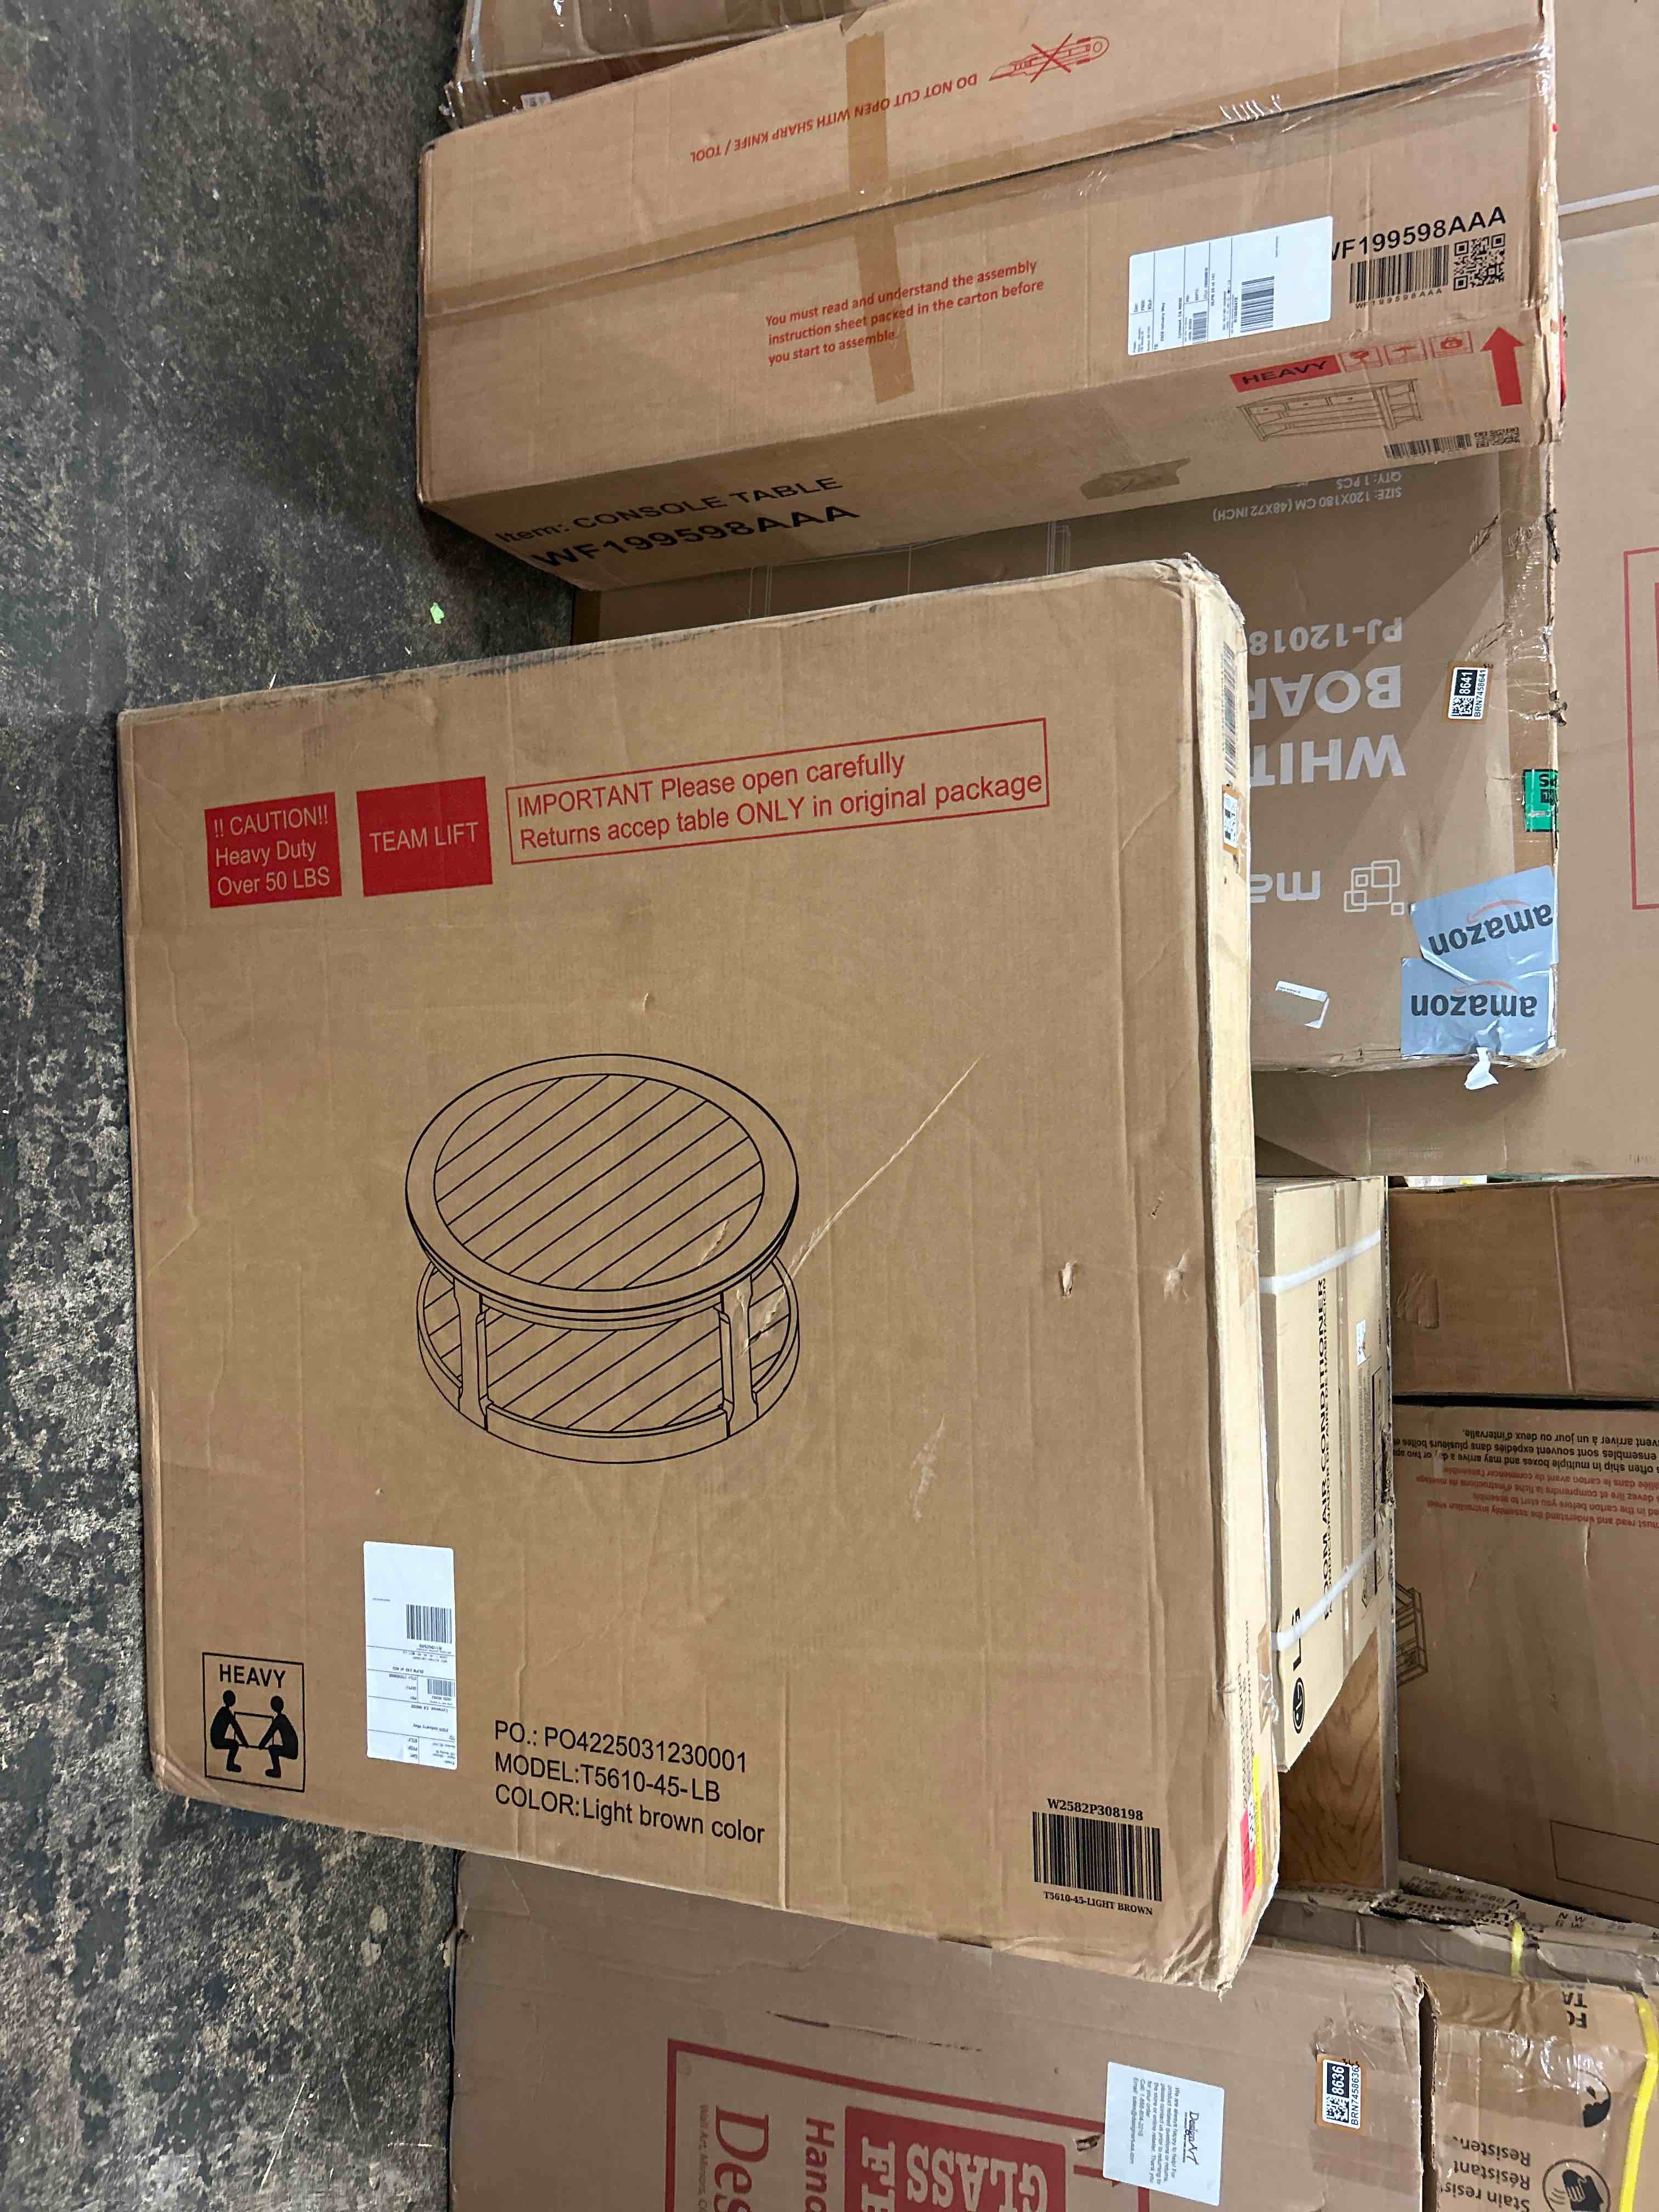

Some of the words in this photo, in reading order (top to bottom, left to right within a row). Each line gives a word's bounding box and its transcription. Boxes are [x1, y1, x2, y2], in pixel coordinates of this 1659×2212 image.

[956, 72, 977, 87] DO
[924, 81, 952, 98] NOT
[894, 89, 919, 107] CUT
[855, 98, 890, 116] OPEN
[816, 107, 851, 127] WITH
[772, 119, 813, 140] SHARP
[725, 138, 732, 155] /
[733, 132, 770, 151] KNIFE
[691, 145, 721, 162] TOOL
[766, 315, 785, 326] You
[789, 307, 819, 322] must
[822, 301, 848, 315] read
[852, 294, 874, 308] and
[878, 278, 949, 304] understand
[952, 274, 973, 286] the
[977, 260, 1037, 284] assembly
[769, 324, 831, 345] instruction
[834, 316, 867, 332] sheet
[871, 305, 913, 326] packed
[917, 304, 929, 315] in
[933, 298, 953, 312] the
[957, 291, 998, 307] carton
[1002, 280, 1043, 298] before
[768, 352, 789, 366] you
[793, 345, 820, 359] start
[823, 342, 836, 353] to
[1242, 359, 1327, 385] HEAVY
[1336, 476, 1360, 490] PCS
[1364, 474, 1369, 487] 1
[1373, 471, 1402, 485] QTY:
[1319, 490, 1370, 509] 120X180
[1374, 486, 1403, 500] SIZE:
[494, 521, 570, 545] Item:
[573, 495, 727, 529] CONSOLE
[730, 477, 843, 504] TABLE
[1251, 498, 1293, 519] (48X72
[1295, 498, 1316, 511] CM
[1212, 507, 1248, 522] INCH)
[531, 505, 860, 567] WF199598AAA
[1459, 672, 1474, 694] 8641
[1474, 669, 1486, 717] BRN7458641
[517, 780, 653, 818] IMPORTANT
[661, 775, 735, 802] Please
[742, 767, 798, 794] open
[806, 751, 905, 782] carefully
[521, 822, 601, 851] Returns
[607, 817, 670, 842] accep
[677, 809, 729, 832] table
[736, 796, 804, 826] ONLY
[813, 795, 832, 818] in
[839, 783, 926, 817] original
[934, 771, 1042, 807] package
[230, 804, 329, 836] CAUTION!!
[370, 827, 428, 853] TEAM
[435, 822, 478, 846] LIFT
[216, 846, 270, 867] Heavy
[276, 839, 317, 861] Duty
[218, 876, 260, 896] Over
[266, 872, 287, 892] 50
[294, 866, 330, 888] LBS
[1427, 904, 1553, 956] amazon
[1410, 994, 1537, 1018] amazon
[1318, 1278, 1326, 1468] CONDITIONER
[1462, 1429, 1513, 1441] d'intervalle.
[1515, 1432, 1537, 1442] deux
[1540, 1434, 1551, 1442] ou
[1554, 1432, 1573, 1443] jour
[1576, 1435, 1589, 1443] un
[1601, 1436, 1633, 1447] arriver
[1430, 1440, 1468, 1452] plusieurs
[1471, 1443, 1492, 1453] dans
[1536, 1446, 1575, 1457] souvent
[1407, 1451, 1421, 1459] two
[1458, 1454, 1481, 1463] arrive
[1484, 1454, 1502, 1464] may
[1578, 1449, 1599, 1458] sont
[1602, 1450, 1656, 1460] ensembles
[1504, 1457, 1520, 1466] and
[1523, 1458, 1549, 1468] boxes
[1552, 1459, 1590, 1471] multiple
[1593, 1463, 1602, 1472] in
[1605, 1462, 1625, 1473] ship
[1628, 1464, 1653, 1474] often
[1548, 1474, 1570, 1483] avant
[1573, 1476, 1601, 1486] carton
[1613, 1479, 1635, 1489] dans
[1514, 1485, 1534, 1494] fiche
[1545, 1486, 1597, 1499] comprendre
[1511, 1496, 1519, 1504] to
[1541, 1498, 1557, 1508] you
[1627, 1492, 1654, 1503] devez
[1491, 1505, 1528, 1518] assembly
[1559, 1500, 1587, 1512] before
[1590, 1504, 1617, 1514] carton
[1620, 1506, 1634, 1515] the
[1636, 1506, 1645, 1516] in
[1545, 1511, 1594, 1524] understand
[1597, 1516, 1613, 1525] and
[1616, 1517, 1635, 1526] read
[219, 1664, 286, 1688] HEAVY
[495, 1720, 537, 1746] PO.:
[545, 1726, 746, 1773] PO4225031230001
[495, 1751, 720, 1803] MODEL:T5610-45-LB
[495, 1784, 633, 1826] COLOR:Light
[640, 1805, 703, 1835] brown
[712, 1819, 765, 1843] color
[1047, 1798, 1144, 1821] W2582P308198
[1043, 1892, 1115, 1910] T5610-45-LIGHT
[1118, 1903, 1153, 1915] BROWN
[1331, 2066, 1344, 2095] 8636
[906, 2142, 1048, 2212] GLASS
[1453, 2160, 1530, 2191] Résistant
[1439, 2181, 1482, 2199] resis
[1487, 2191, 1530, 2212] Stain
